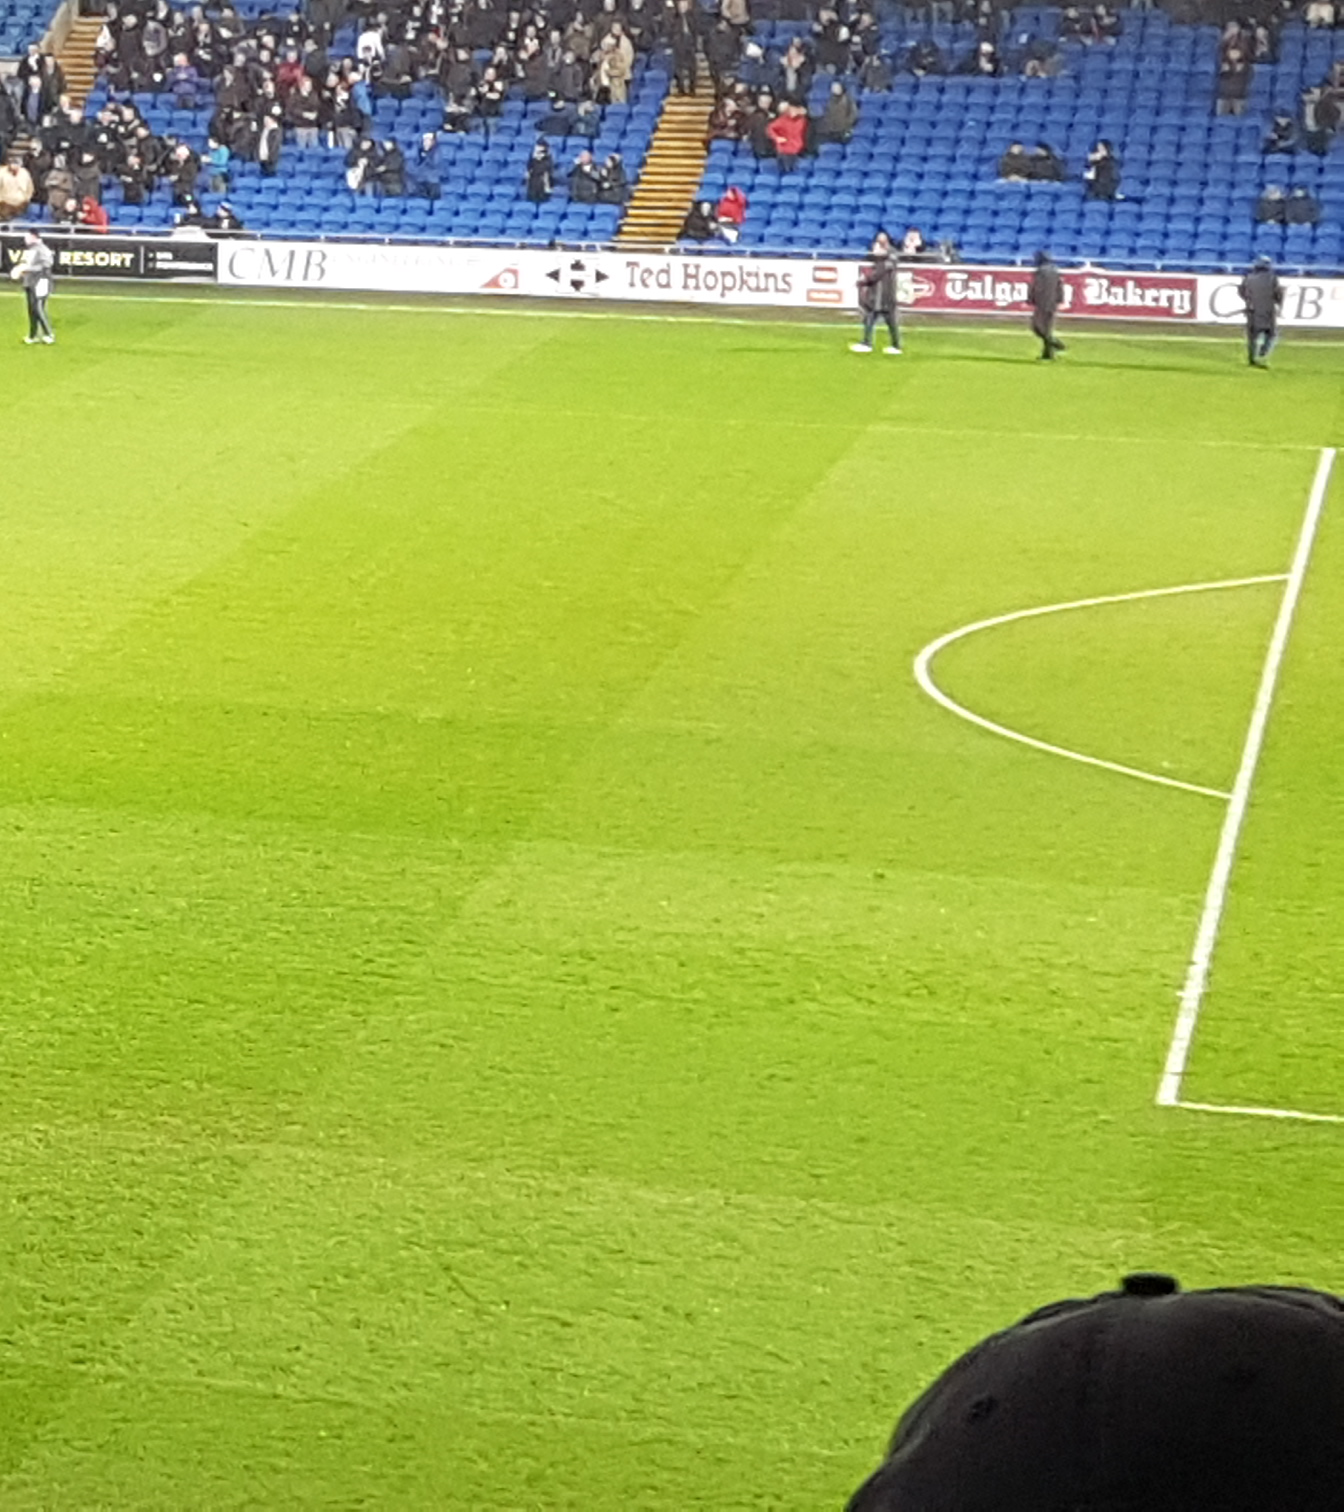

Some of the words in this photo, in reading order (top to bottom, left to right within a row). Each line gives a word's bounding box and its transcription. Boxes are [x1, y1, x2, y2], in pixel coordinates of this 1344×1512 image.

[59, 250, 134, 268] RESORT
[226, 246, 329, 282] CMB
[625, 261, 672, 289] Ted
[681, 262, 793, 297] Hopkins
[1084, 277, 1193, 314] Bakery
[1209, 280, 1325, 320] CB
